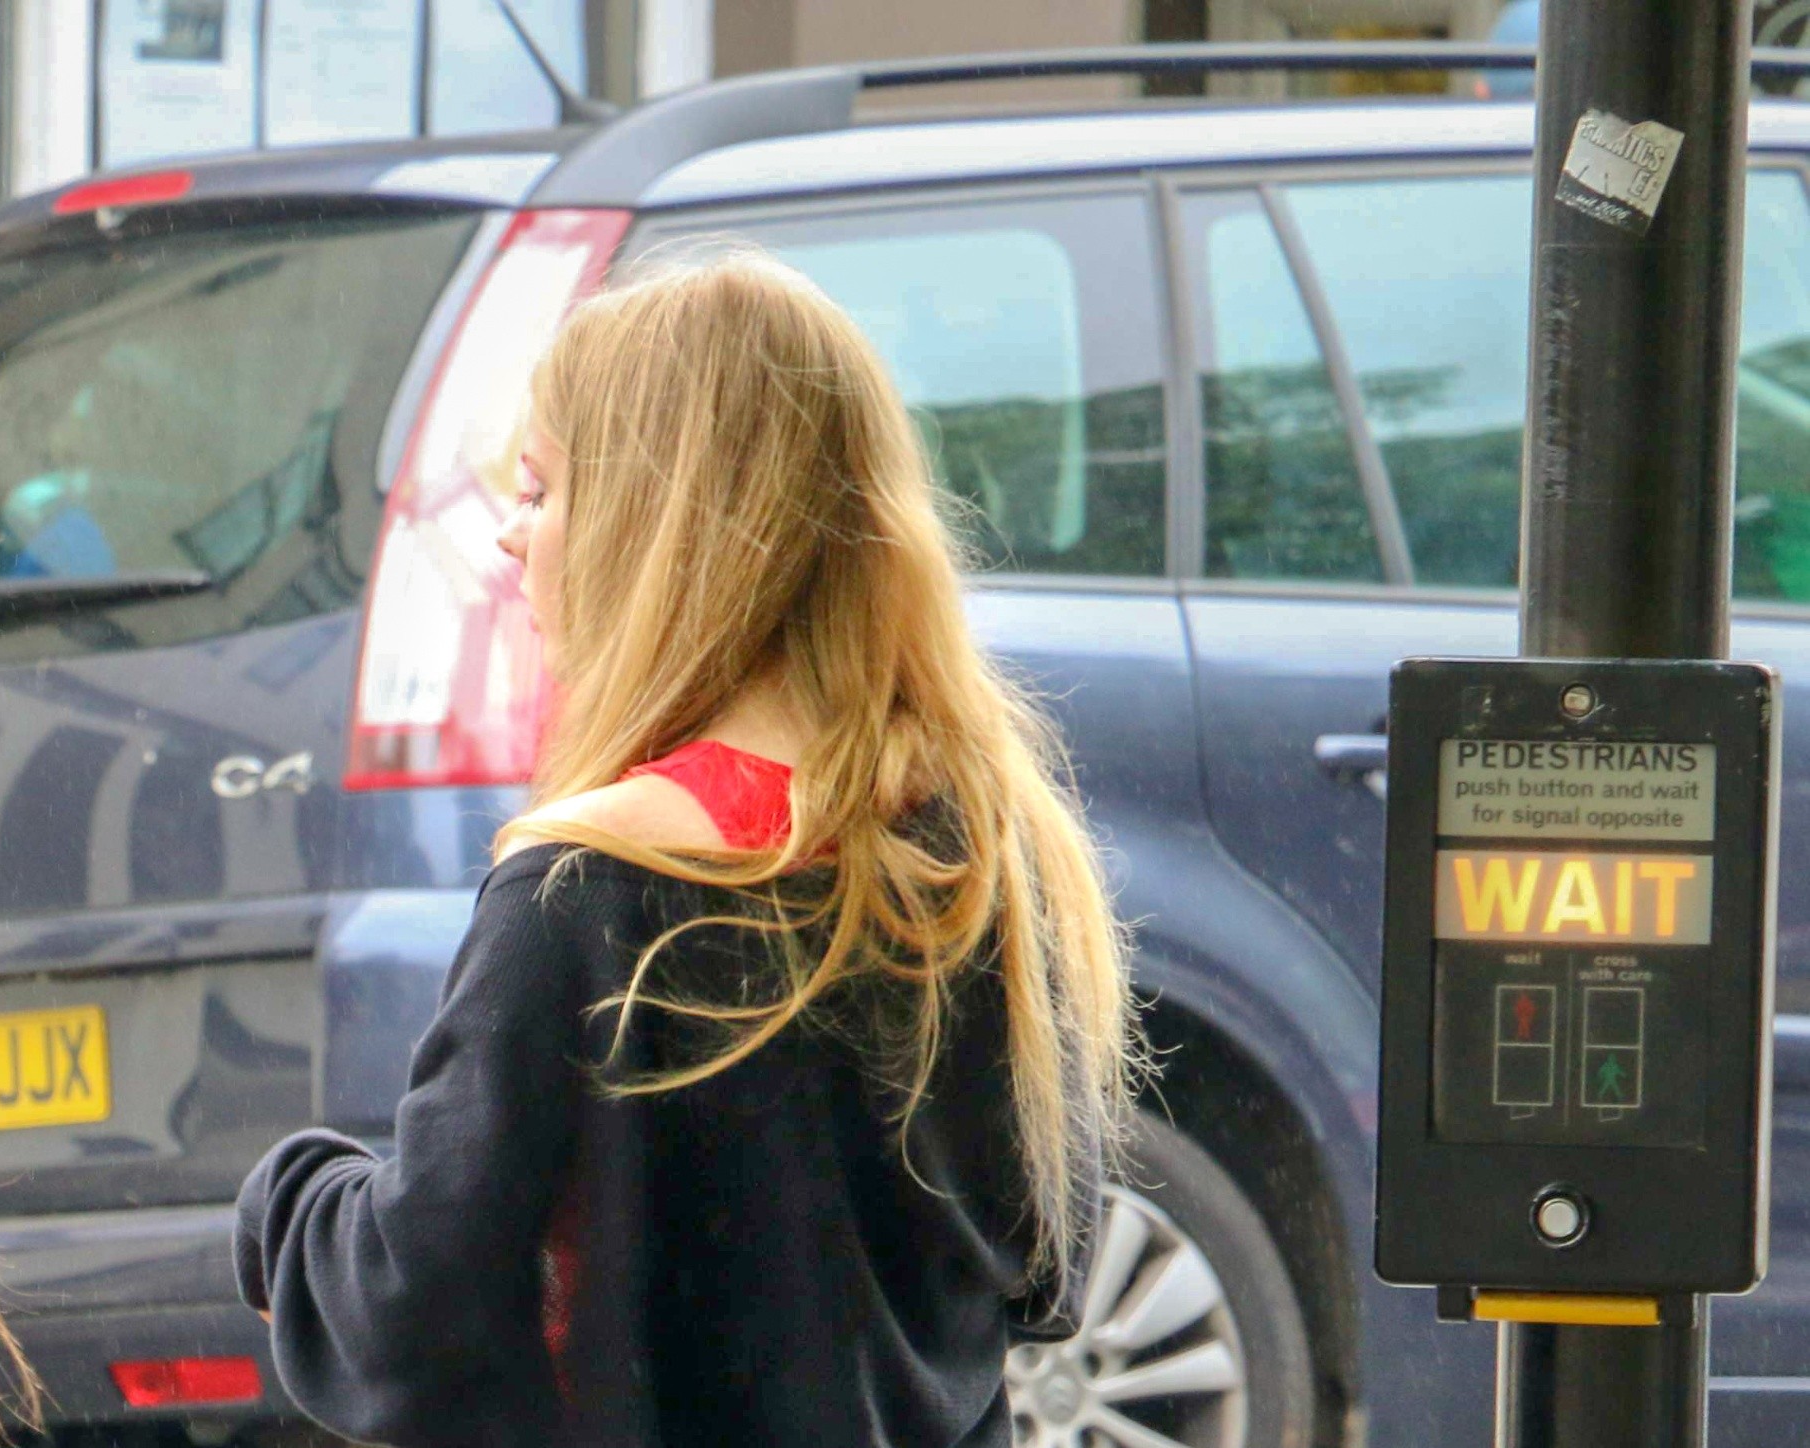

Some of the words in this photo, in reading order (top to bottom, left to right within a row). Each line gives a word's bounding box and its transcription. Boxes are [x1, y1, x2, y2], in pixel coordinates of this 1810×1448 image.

[1457, 741, 1698, 772] PEDESTRIANS
[211, 754, 313, 799] C4
[1455, 778, 1510, 799] push
[1518, 778, 1593, 798] button
[1603, 780, 1644, 798] and
[1650, 781, 1699, 800] wait
[1472, 803, 1504, 822] for
[1512, 805, 1580, 828] signal
[1586, 807, 1684, 829] opposite
[1453, 858, 1695, 937] WAIT
[1504, 952, 1541, 965] wait
[1593, 955, 1638, 967] cross
[1617, 970, 1653, 982] care
